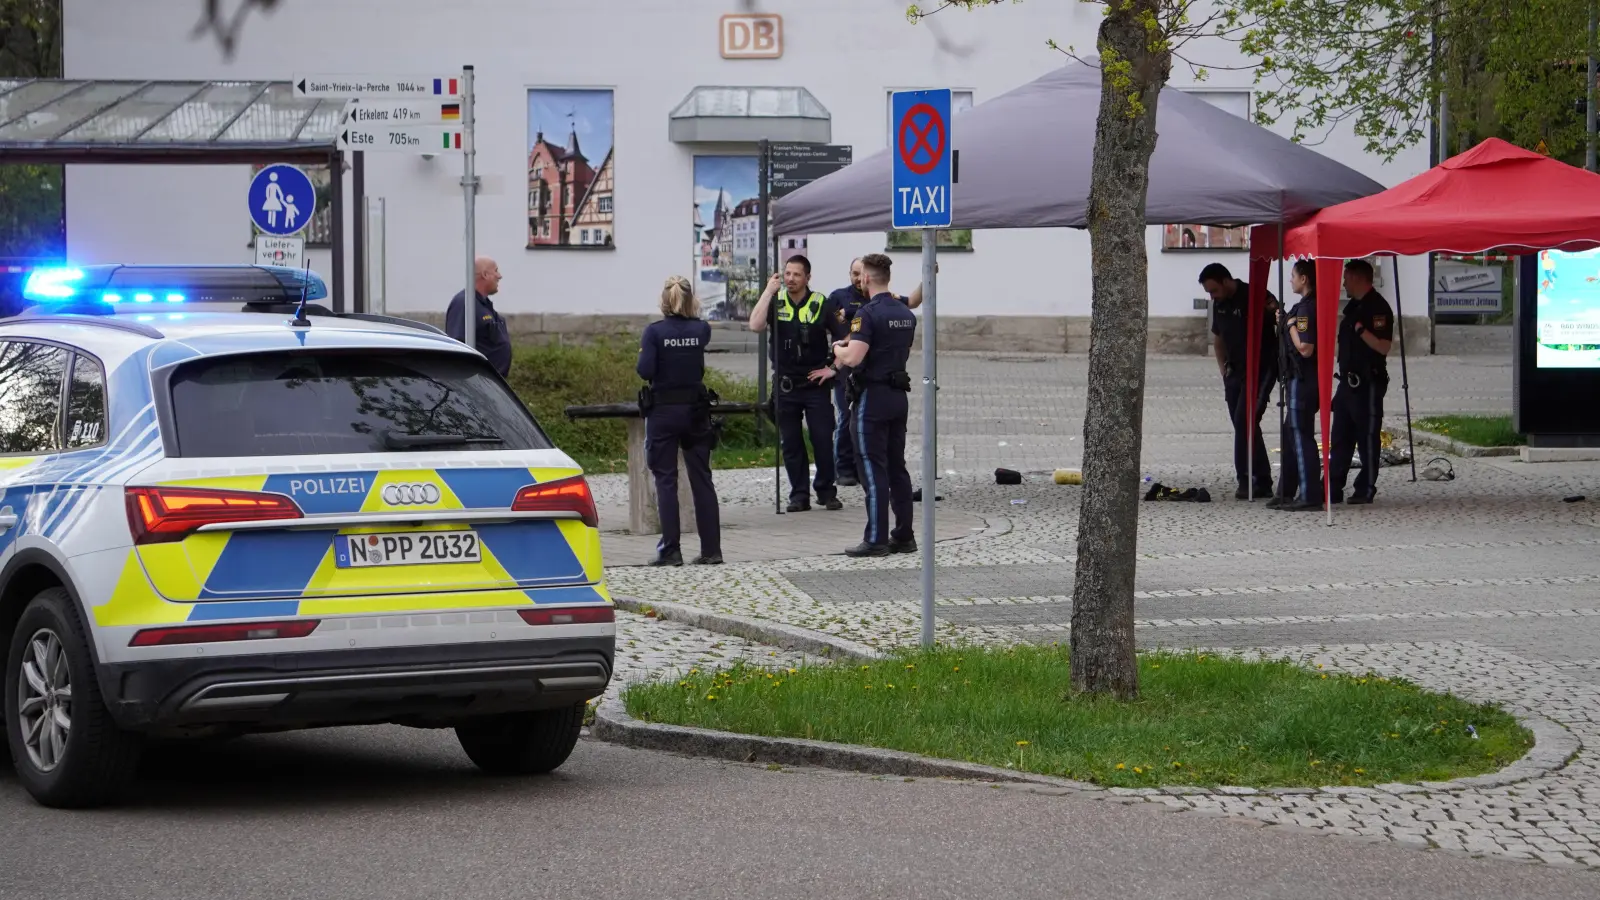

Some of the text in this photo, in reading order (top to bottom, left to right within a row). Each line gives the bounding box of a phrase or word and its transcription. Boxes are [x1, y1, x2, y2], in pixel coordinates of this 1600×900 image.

[728, 21, 775, 51] DB
[310, 83, 390, 92] Saint-Yrieix-la-Perche
[397, 82, 415, 92] 1044
[359, 108, 421, 120] Erkelenz 419 km
[351, 131, 374, 144] Este
[773, 163, 798, 171] Minigolf
[898, 185, 945, 215] TAXI
[888, 320, 913, 329] POLIZEI
[663, 337, 699, 348] POLIZEI
[80, 422, 100, 439] 110
[290, 477, 366, 496] POLIZEI
[351, 533, 478, 563] N PP 2032
